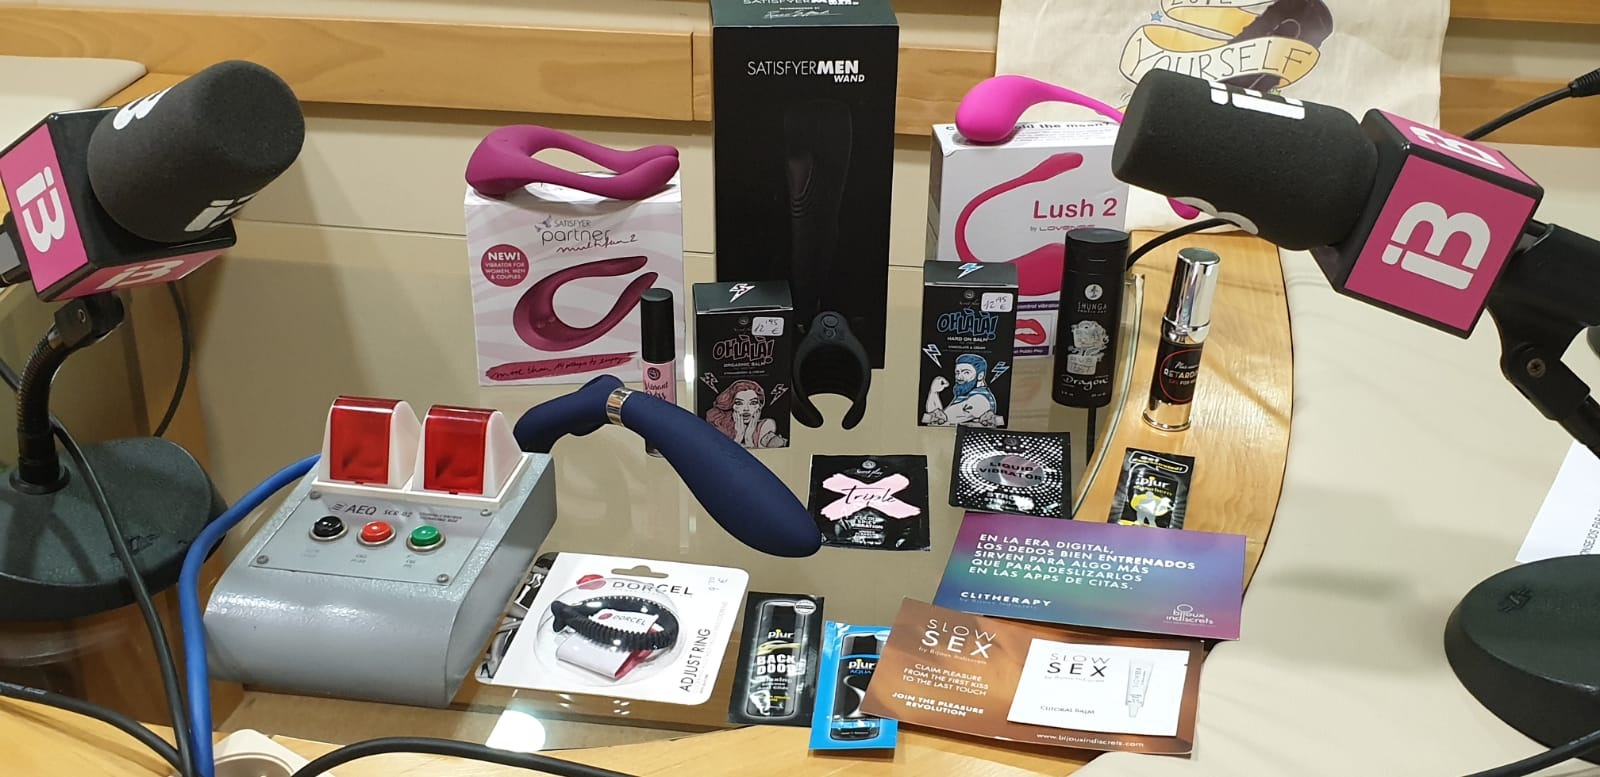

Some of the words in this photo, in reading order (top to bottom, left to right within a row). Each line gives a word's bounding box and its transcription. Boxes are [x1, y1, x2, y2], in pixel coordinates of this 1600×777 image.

[1129, 38, 1313, 83] YOURSELF
[833, 75, 865, 83] WAND
[1033, 198, 1094, 219] Lush
[1102, 197, 1118, 217] 2
[553, 218, 593, 228] SATISFYER
[541, 229, 612, 246] partner
[488, 251, 521, 261] NEW!
[1061, 374, 1110, 392] Dragon
[979, 467, 1042, 481] VIBRATOR
[989, 462, 1034, 472] LIQUID
[344, 504, 377, 516] AEQ
[979, 533, 998, 542] EN
[1003, 536, 1019, 545] LA
[1025, 538, 1050, 547] ERA
[1056, 541, 1115, 554] DIGITAL,
[974, 550, 1024, 562] SIRVEN
[1029, 556, 1065, 566] PARA
[1071, 560, 1111, 570] ALGO
[1117, 564, 1149, 574] MÁS
[977, 542, 1003, 551] LOS
[1008, 545, 1055, 556] DEDOS
[1060, 550, 1093, 560] BIEN
[1098, 554, 1196, 570] ENTRENADOS
[969, 566, 988, 575] EN
[993, 569, 1018, 578] LAS
[1023, 573, 1059, 582] APPS
[1065, 576, 1083, 585] DE
[1088, 579, 1134, 590] CITAS.
[971, 558, 1000, 568] QUE
[1006, 562, 1042, 572] PARA
[1048, 566, 1143, 582] DESLIZARLOS
[612, 581, 694, 596] DORCEL
[960, 591, 1052, 607] CLITHERAPY
[612, 614, 647, 626] DORCEL
[767, 628, 795, 639] pjur
[927, 618, 997, 642] SLOW
[921, 630, 993, 659] SEX
[678, 653, 702, 693] ADJUST
[691, 628, 711, 653] RING
[756, 653, 796, 666] BACK
[848, 658, 876, 670] pjur
[914, 663, 942, 673] CLAIM
[942, 669, 983, 682] PLEASURE
[1047, 661, 1108, 678] SEX
[902, 674, 914, 682] TO
[916, 678, 933, 686] THE
[933, 680, 954, 690] LAST
[955, 685, 987, 696] TOUCH
[903, 667, 929, 678] FROM
[931, 674, 946, 682] THE
[947, 677, 971, 686] FIRST
[971, 682, 989, 690] KISS
[892, 692, 916, 701] JOIN
[918, 697, 936, 705] THE
[937, 700, 985, 714] PLEASURE
[905, 701, 967, 717] REVOLUTION
